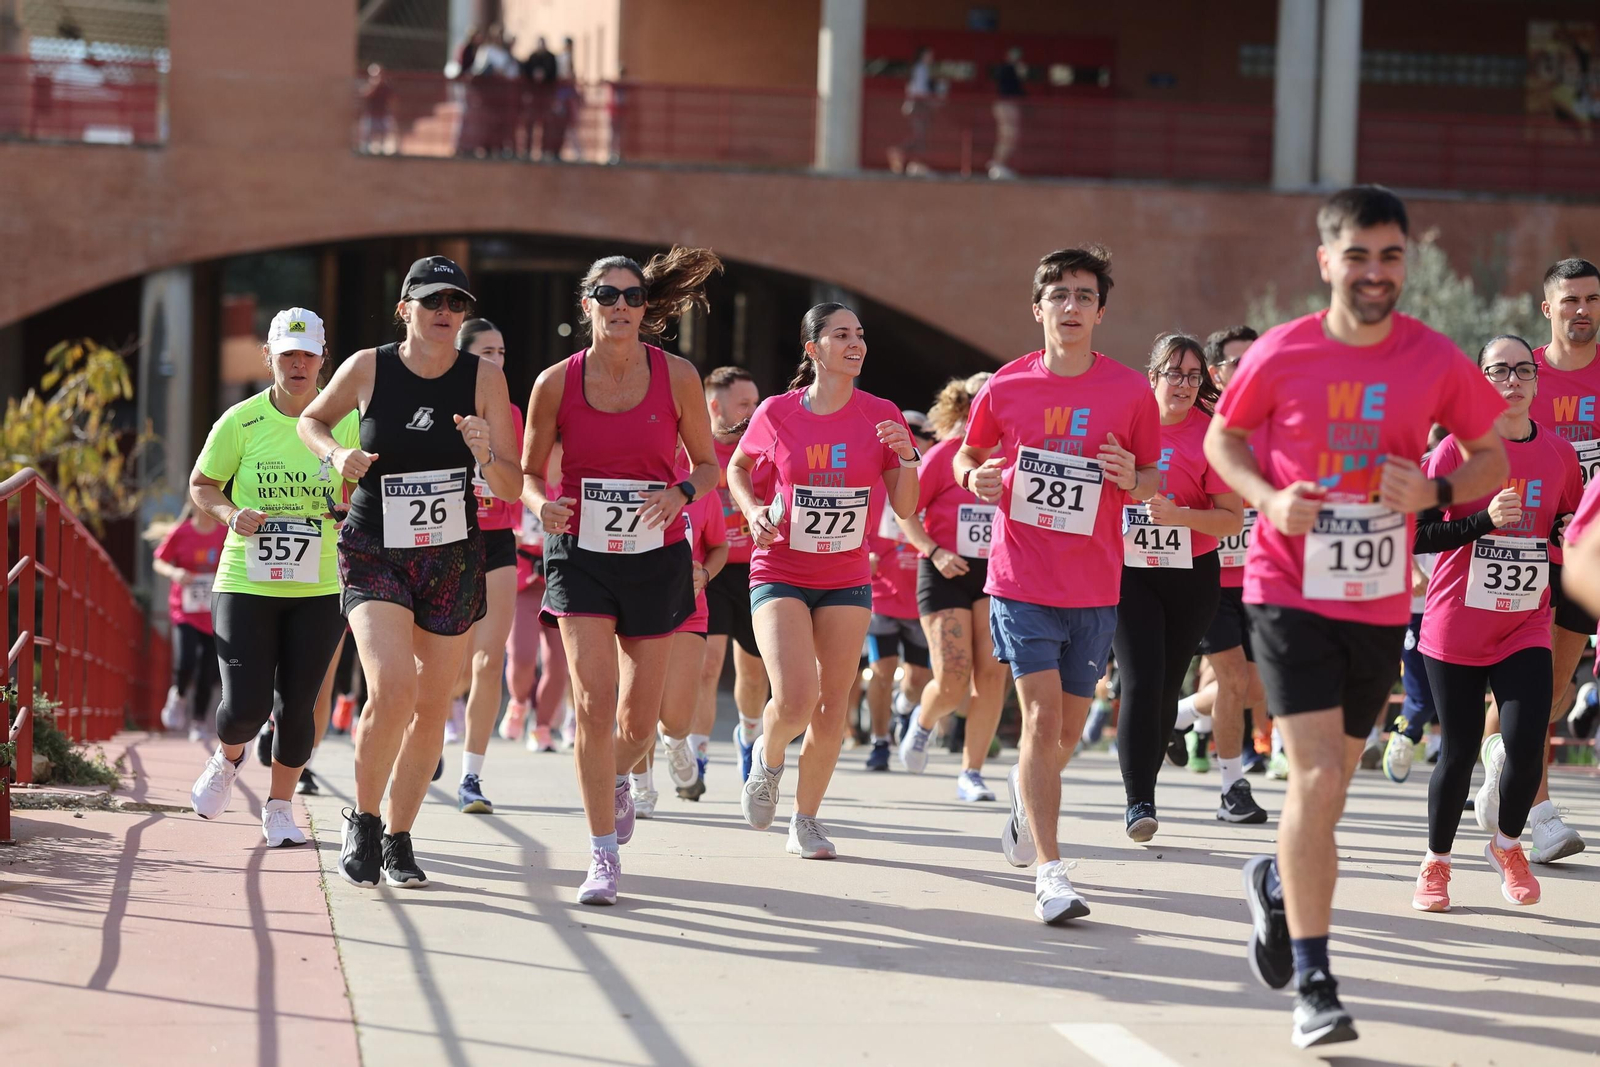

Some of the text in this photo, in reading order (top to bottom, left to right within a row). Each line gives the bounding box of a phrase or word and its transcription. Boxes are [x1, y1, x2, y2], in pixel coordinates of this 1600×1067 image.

[434, 266, 454, 274] SILVER
[1327, 381, 1387, 420] WE
[1552, 395, 1596, 422] WE
[1044, 406, 1091, 437] WE
[806, 443, 847, 469] WE
[1021, 459, 1059, 476] UMA
[256, 472, 307, 484] YO NO
[257, 485, 335, 499] RENUNCIO
[386, 485, 426, 495] UMA
[586, 490, 624, 502] UMA
[1026, 477, 1084, 512] 281
[797, 496, 831, 507] UMA
[409, 498, 447, 526] 26
[605, 506, 642, 532] 27
[260, 523, 282, 532] MA
[804, 511, 856, 535] 272
[1038, 515, 1053, 525] WE
[1316, 519, 1363, 533] UMA
[415, 535, 430, 543] WE
[608, 542, 623, 550] WE
[1134, 528, 1181, 551] 414
[258, 537, 310, 562] 557
[1328, 535, 1395, 571] 190
[1478, 547, 1514, 559] UMA
[1483, 563, 1538, 591] 332
[1496, 600, 1511, 608] WE
